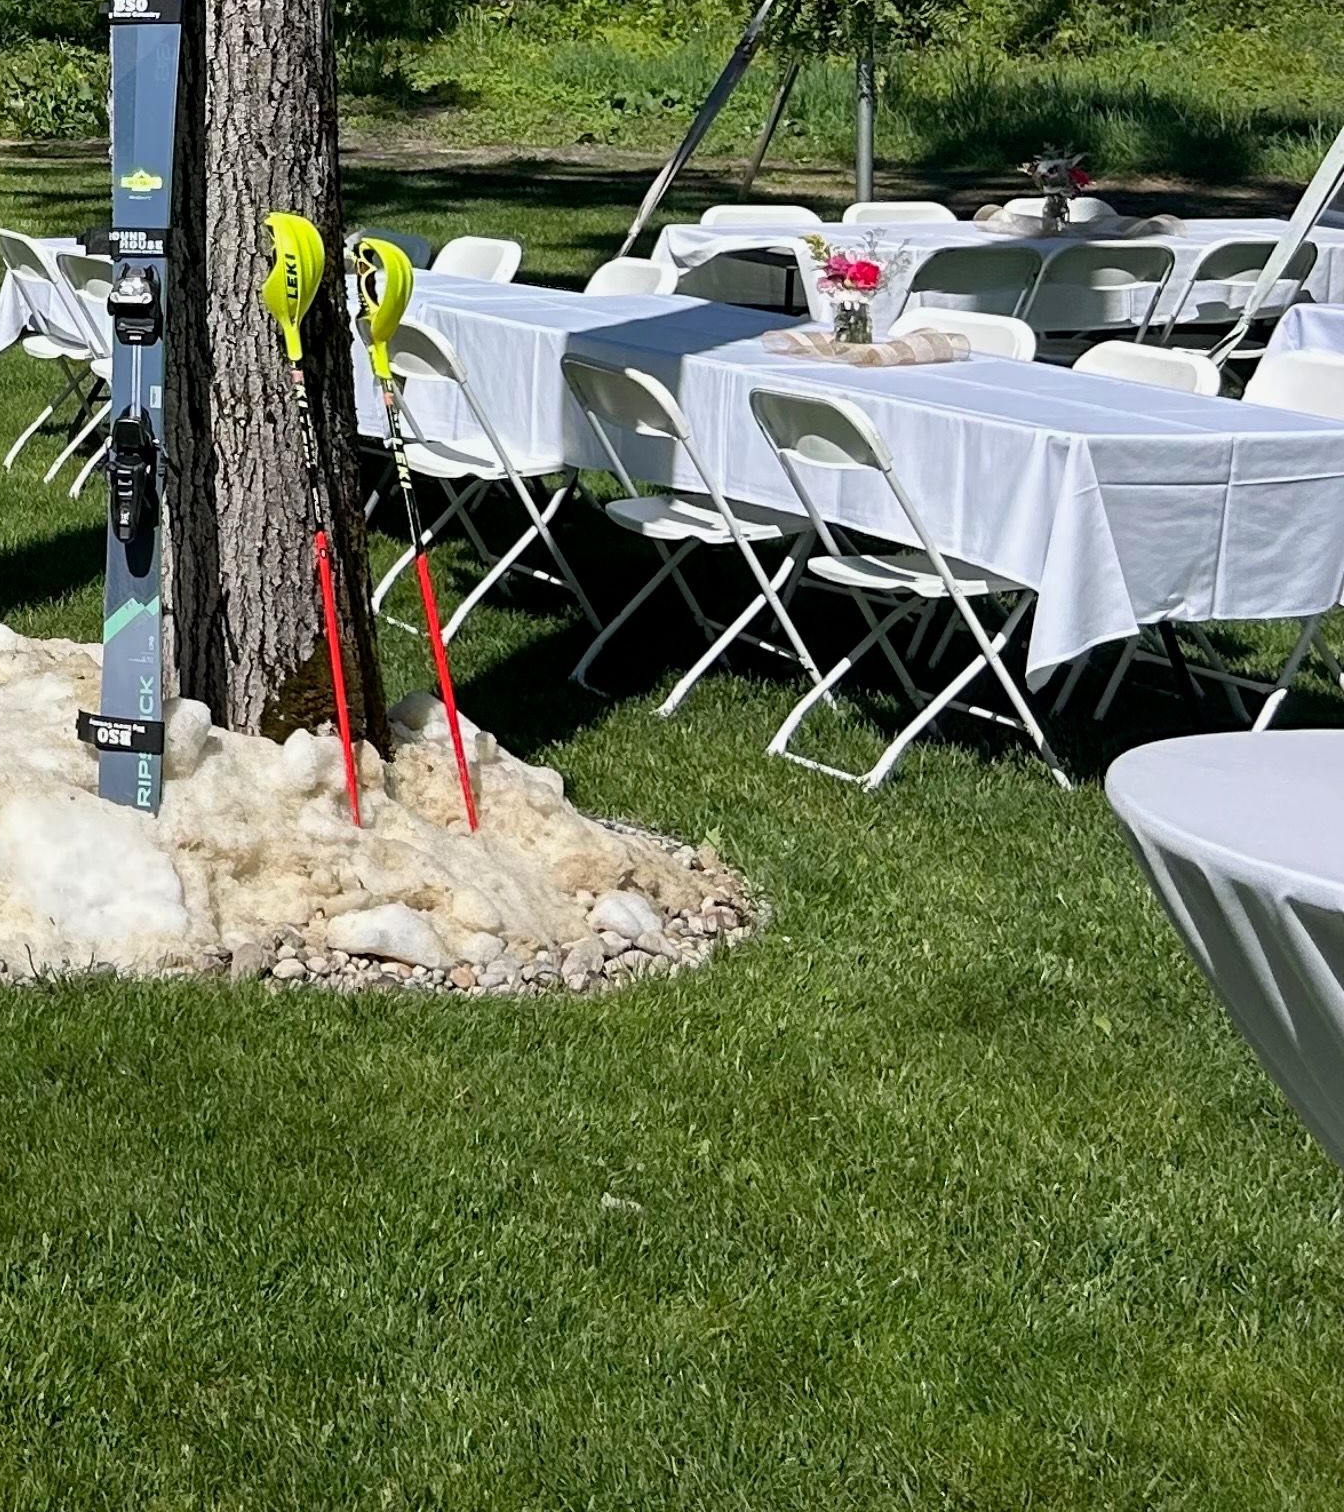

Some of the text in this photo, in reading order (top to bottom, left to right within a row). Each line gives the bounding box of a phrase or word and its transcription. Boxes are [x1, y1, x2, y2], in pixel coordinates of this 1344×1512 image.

[285, 253, 299, 300] LEKI
[392, 437, 413, 489] LEKI
[97, 727, 132, 747] BSO
[137, 675, 155, 808] RIPICK
